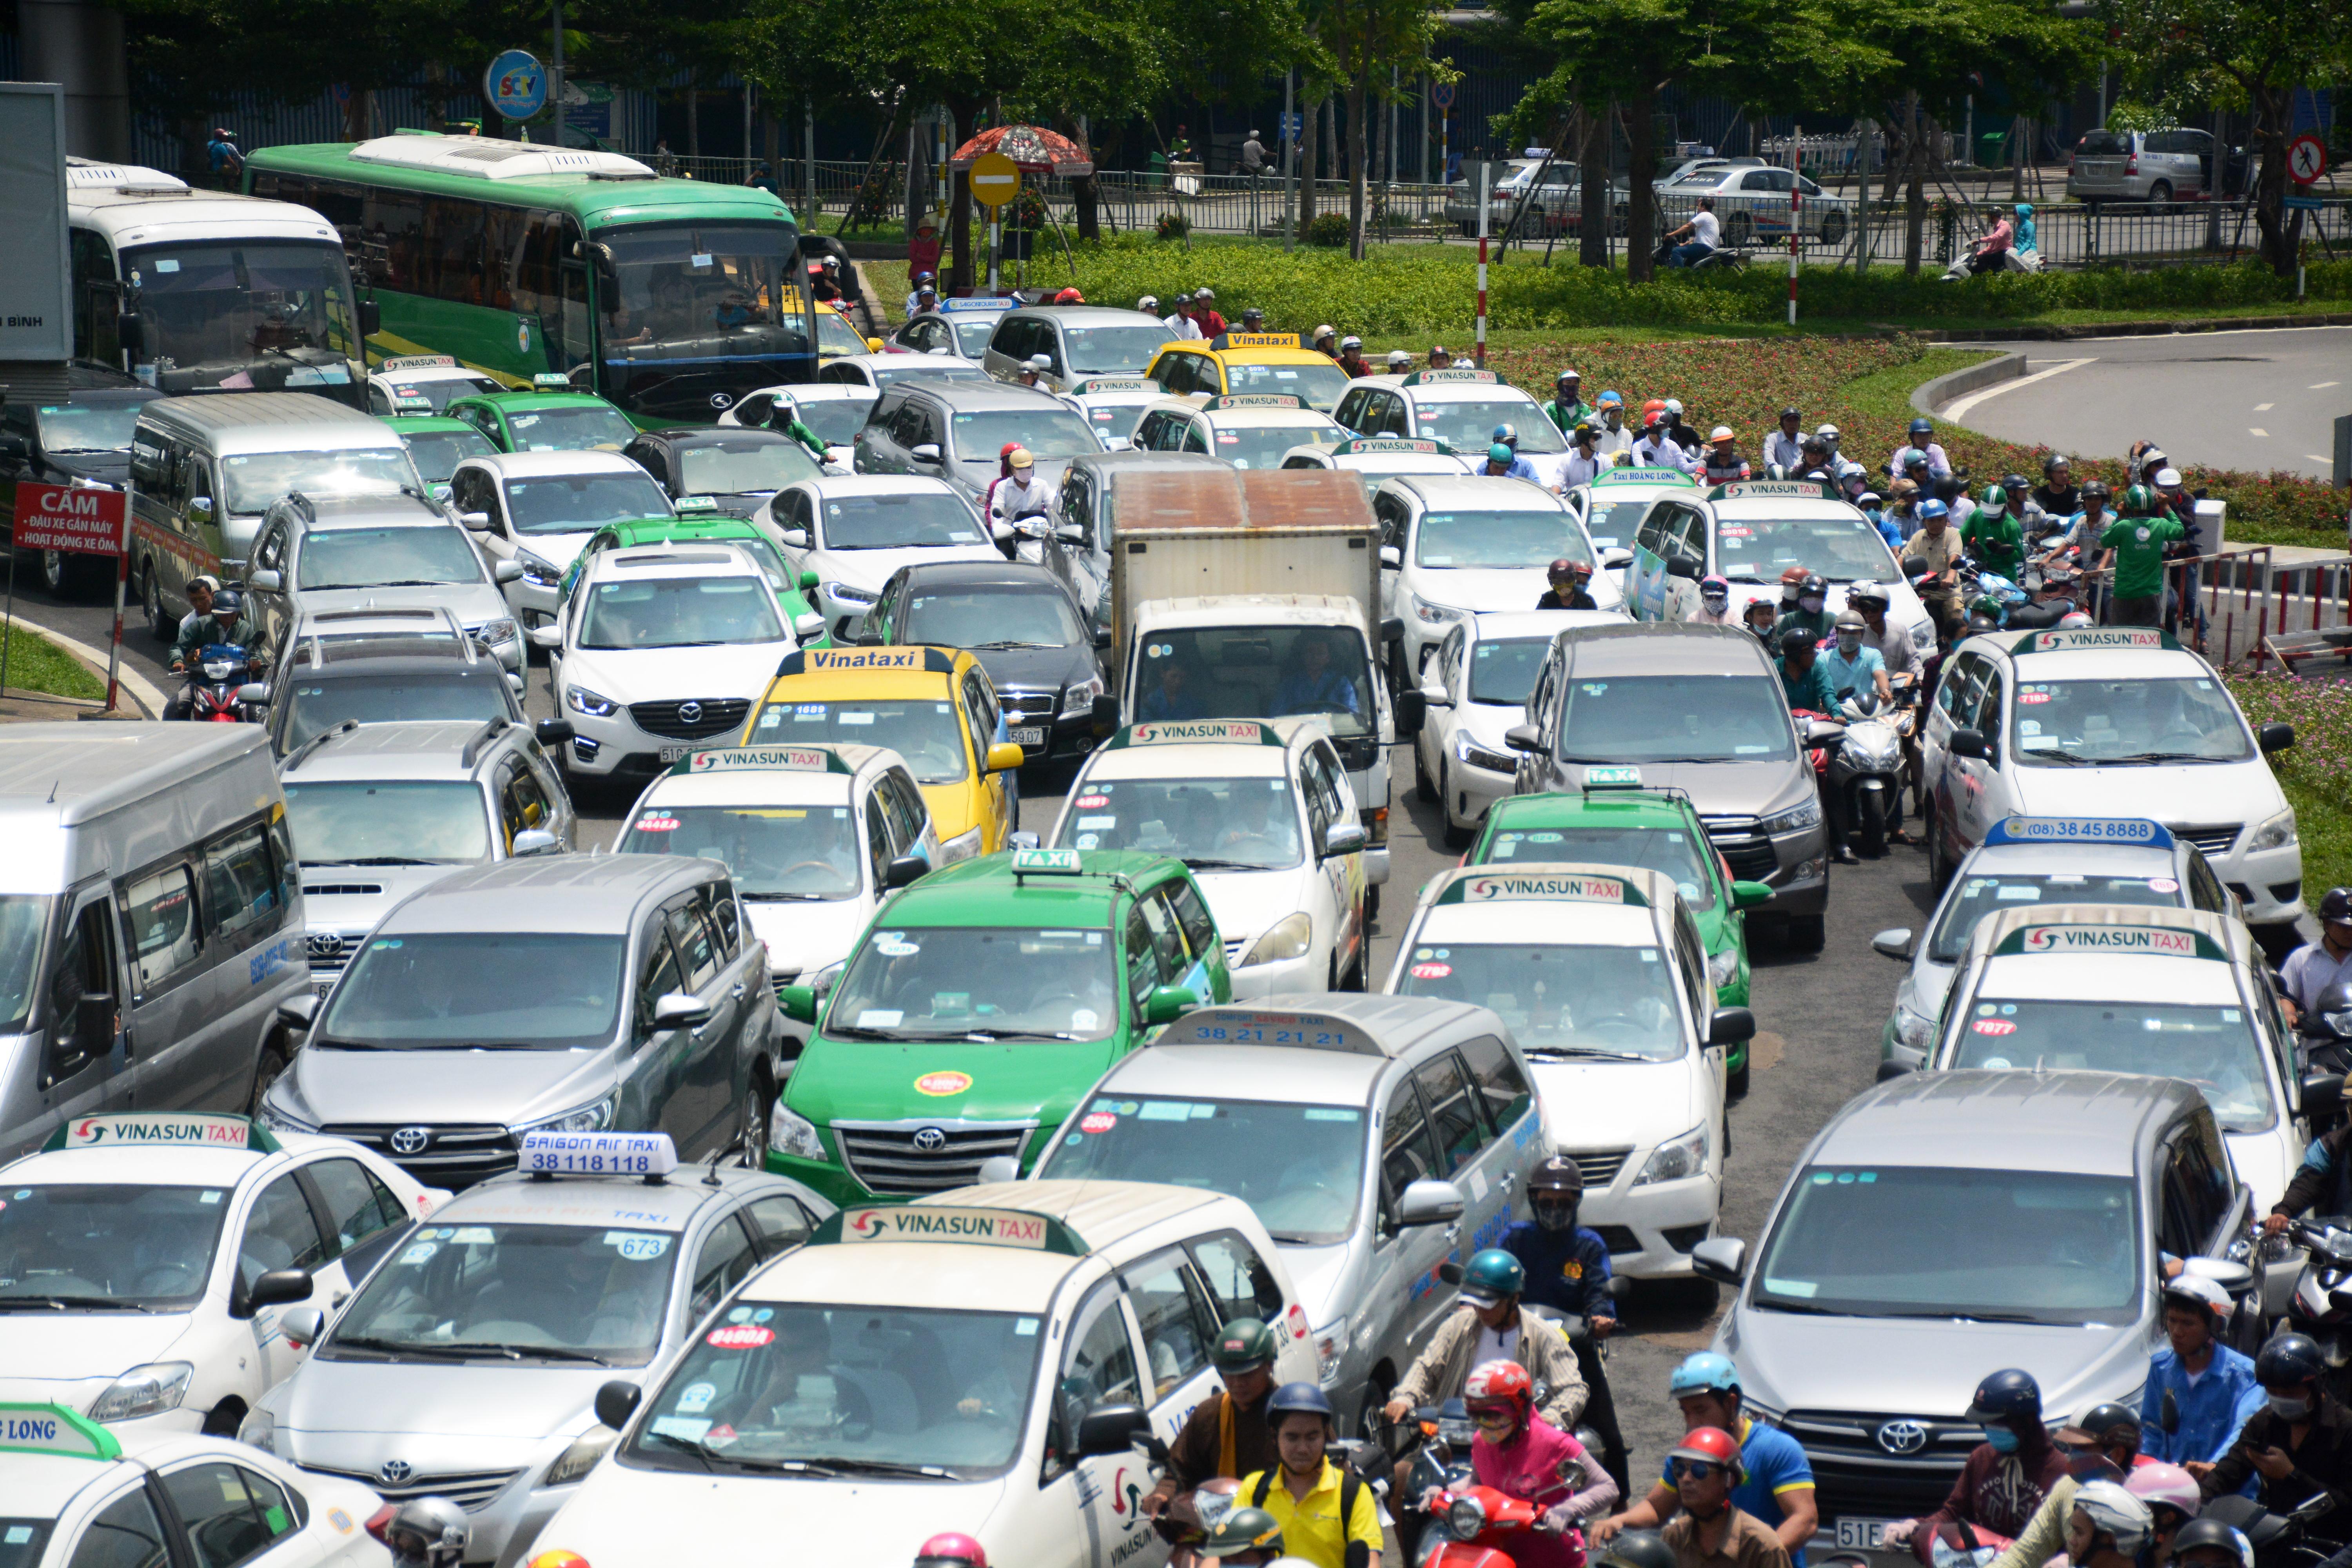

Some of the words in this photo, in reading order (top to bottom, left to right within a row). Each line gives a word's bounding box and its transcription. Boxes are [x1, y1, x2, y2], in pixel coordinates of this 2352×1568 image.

[501, 76, 537, 96] SCTV
[8, 316, 42, 327] BÌNH
[1233, 335, 1293, 345] Vinataxi
[400, 358, 436, 367] VINASUN
[437, 357, 454, 365] TAXI
[1371, 442, 1414, 450] VINASUN
[1630, 470, 1654, 480] HOÀNG
[1751, 485, 1798, 494] VINASUN
[1799, 485, 1820, 494] TAXI
[41, 486, 98, 515] CẤM
[29, 516, 51, 531] ĐẬU
[53, 517, 65, 528] XE
[90, 521, 113, 534] MÁY
[25, 532, 51, 548] HOẠT
[53, 534, 82, 551] ĐỘNG
[84, 537, 96, 549] XE
[98, 537, 114, 551] ÔM
[2069, 634, 2131, 645] VINASUN
[2132, 634, 2160, 645] TAXI
[814, 652, 915, 668] Vinataxi
[1162, 725, 1226, 737] VINASUN
[1229, 726, 1257, 737] TAXI
[723, 753, 788, 765] VINASUN
[791, 753, 819, 766] TAXI
[2028, 824, 2055, 837] (08)
[2057, 822, 2078, 836] 38
[2081, 822, 2102, 836] 45
[2106, 823, 2149, 837] 8888
[1504, 880, 1582, 894] VINASUN
[1585, 881, 1621, 898] TAXI
[2065, 931, 2150, 946] VINASUN
[2152, 933, 2189, 951] TAXI
[1299, 1016, 1324, 1026] TAXI
[1977, 1021, 2013, 1034] 7977
[1197, 1027, 1227, 1040] 38
[1236, 1029, 1263, 1041] 21
[1276, 1031, 1303, 1043] 21
[1316, 1033, 1343, 1045] 21
[115, 1124, 203, 1140] VINASUN
[207, 1125, 247, 1143] TAXI
[525, 1137, 591, 1149] SAIGON
[627, 1139, 660, 1152] TAXI
[532, 1154, 559, 1169] 38
[567, 1155, 603, 1171] 118
[612, 1155, 649, 1172] 118
[613, 1210, 669, 1223] TAXI
[896, 1214, 994, 1235] VINASUN
[998, 1219, 1042, 1240] TAXI
[623, 1239, 660, 1255] 673
[8, 1420, 56, 1439] LONG
[1111, 1527, 1152, 1567] VINASUN
